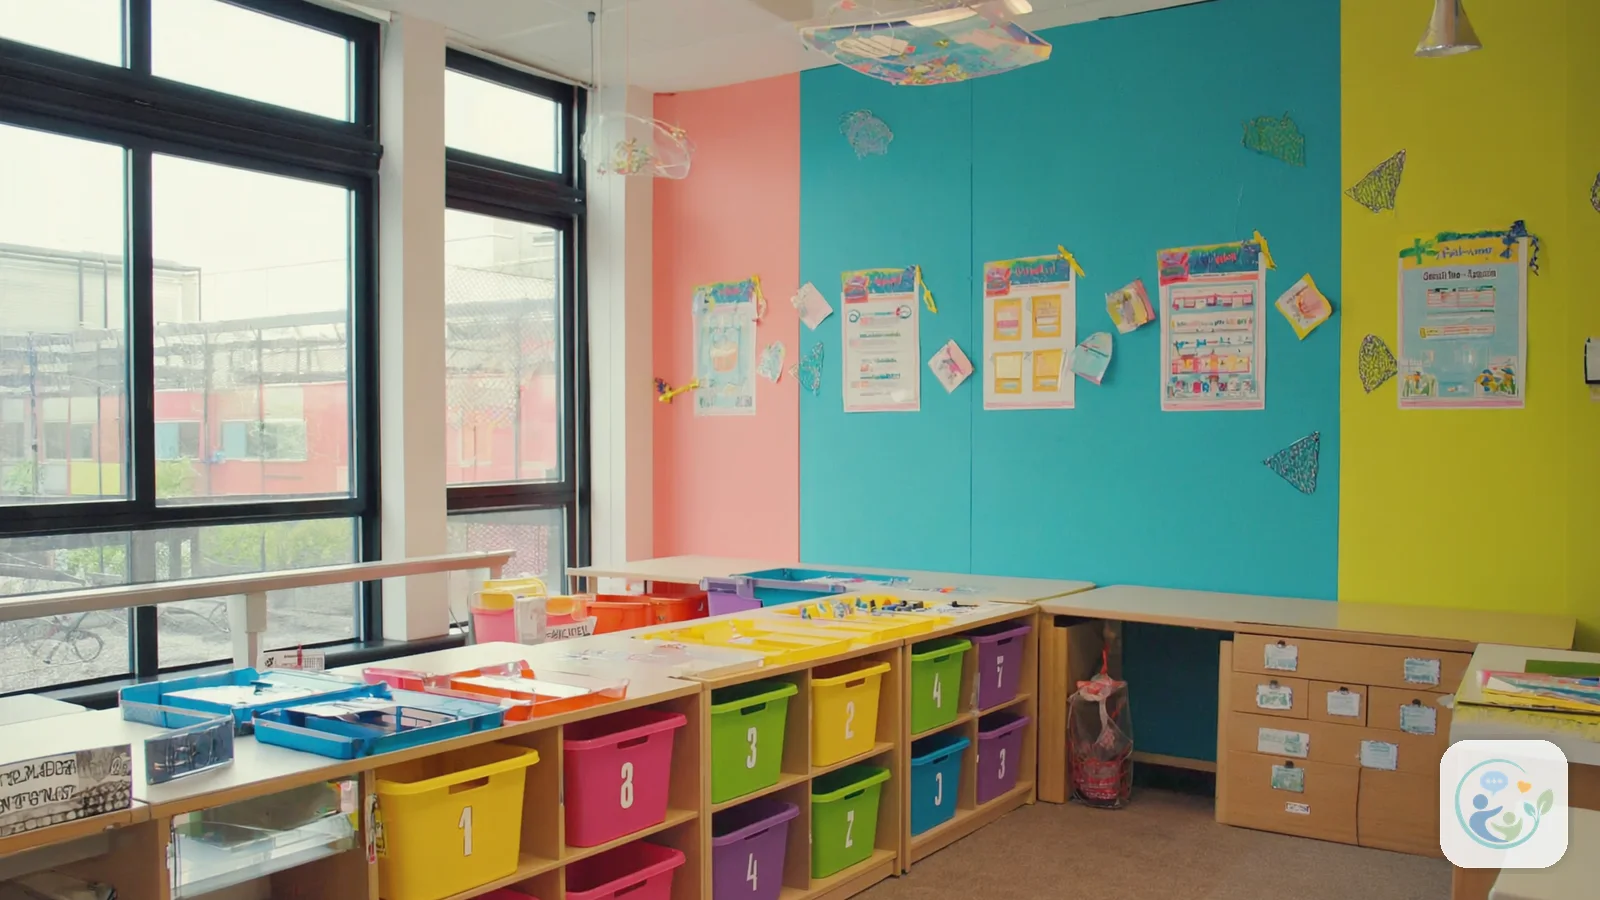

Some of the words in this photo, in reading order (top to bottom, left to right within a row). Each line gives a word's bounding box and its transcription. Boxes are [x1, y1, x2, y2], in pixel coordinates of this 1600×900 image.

[931, 671, 942, 709] 4
[845, 701, 856, 741] 2
[746, 726, 758, 770] 3
[997, 748, 1007, 780] 3
[619, 761, 635, 810] 8
[458, 807, 473, 857] 1
[746, 853, 759, 892] 4
